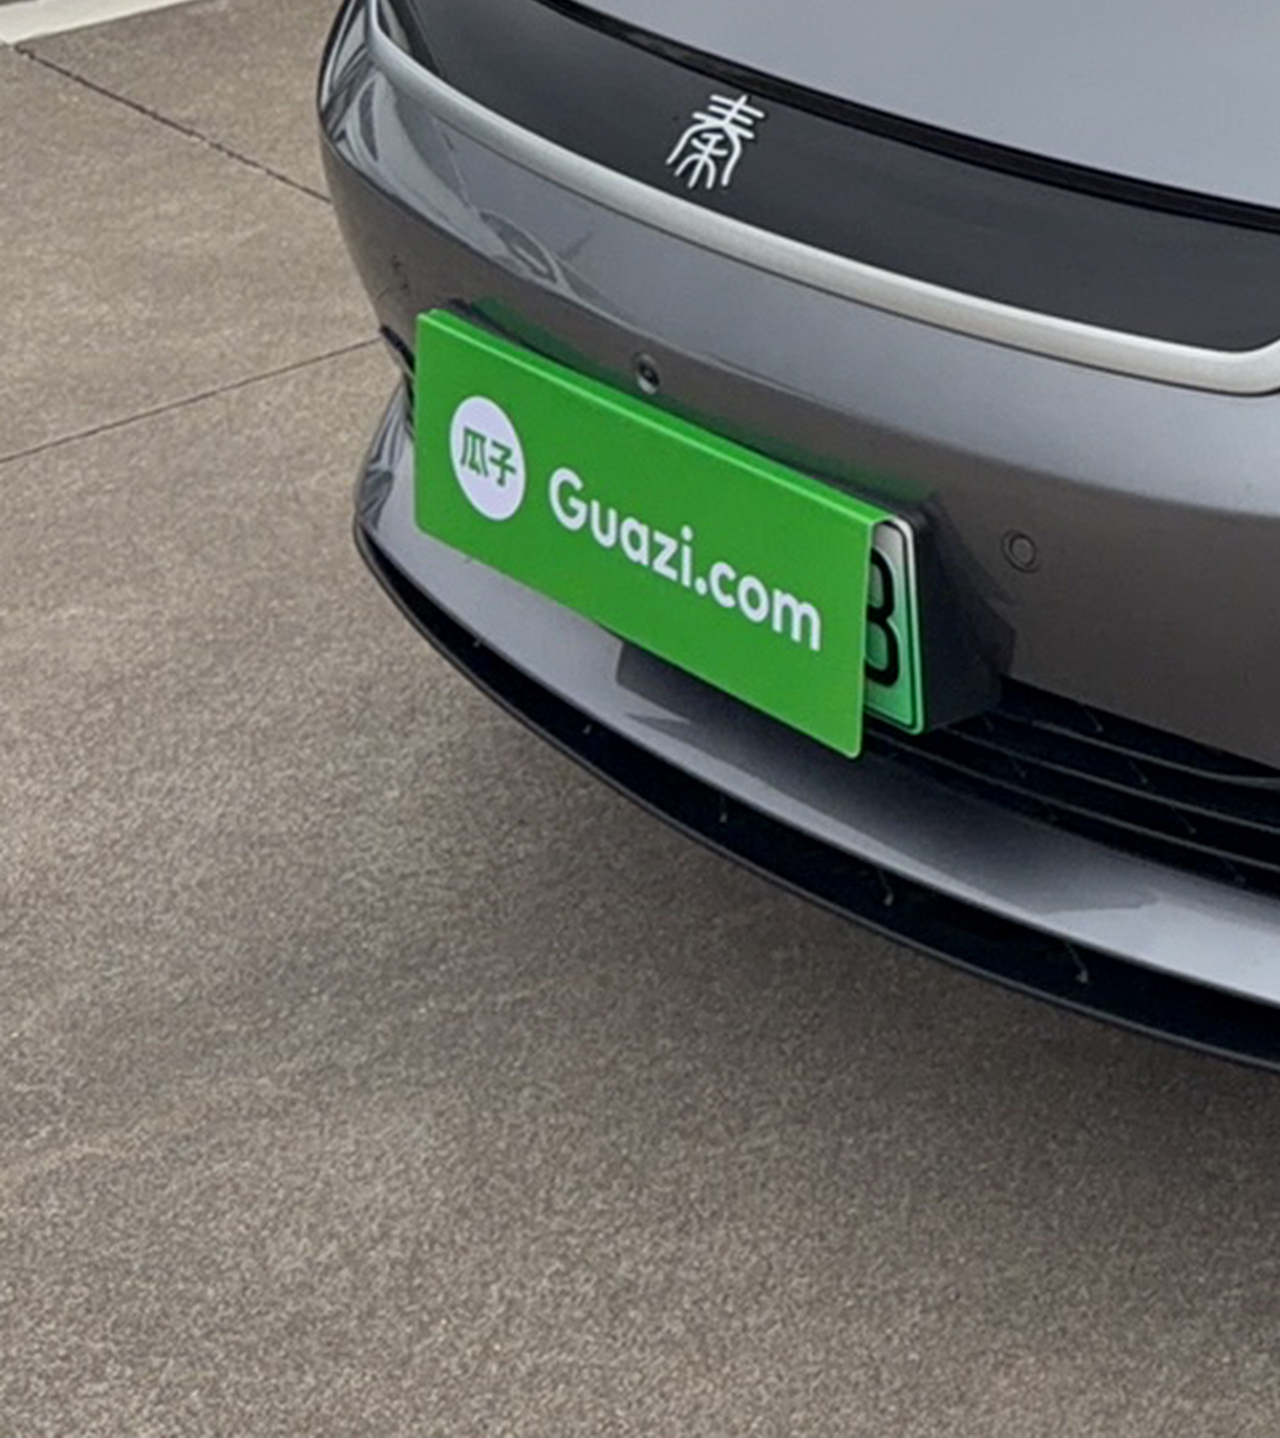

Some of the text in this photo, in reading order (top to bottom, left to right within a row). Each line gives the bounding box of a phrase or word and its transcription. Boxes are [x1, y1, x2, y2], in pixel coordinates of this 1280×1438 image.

[665, 94, 765, 189] 秦
[460, 426, 517, 488] 瓜子
[548, 466, 821, 652] Guazi.com
